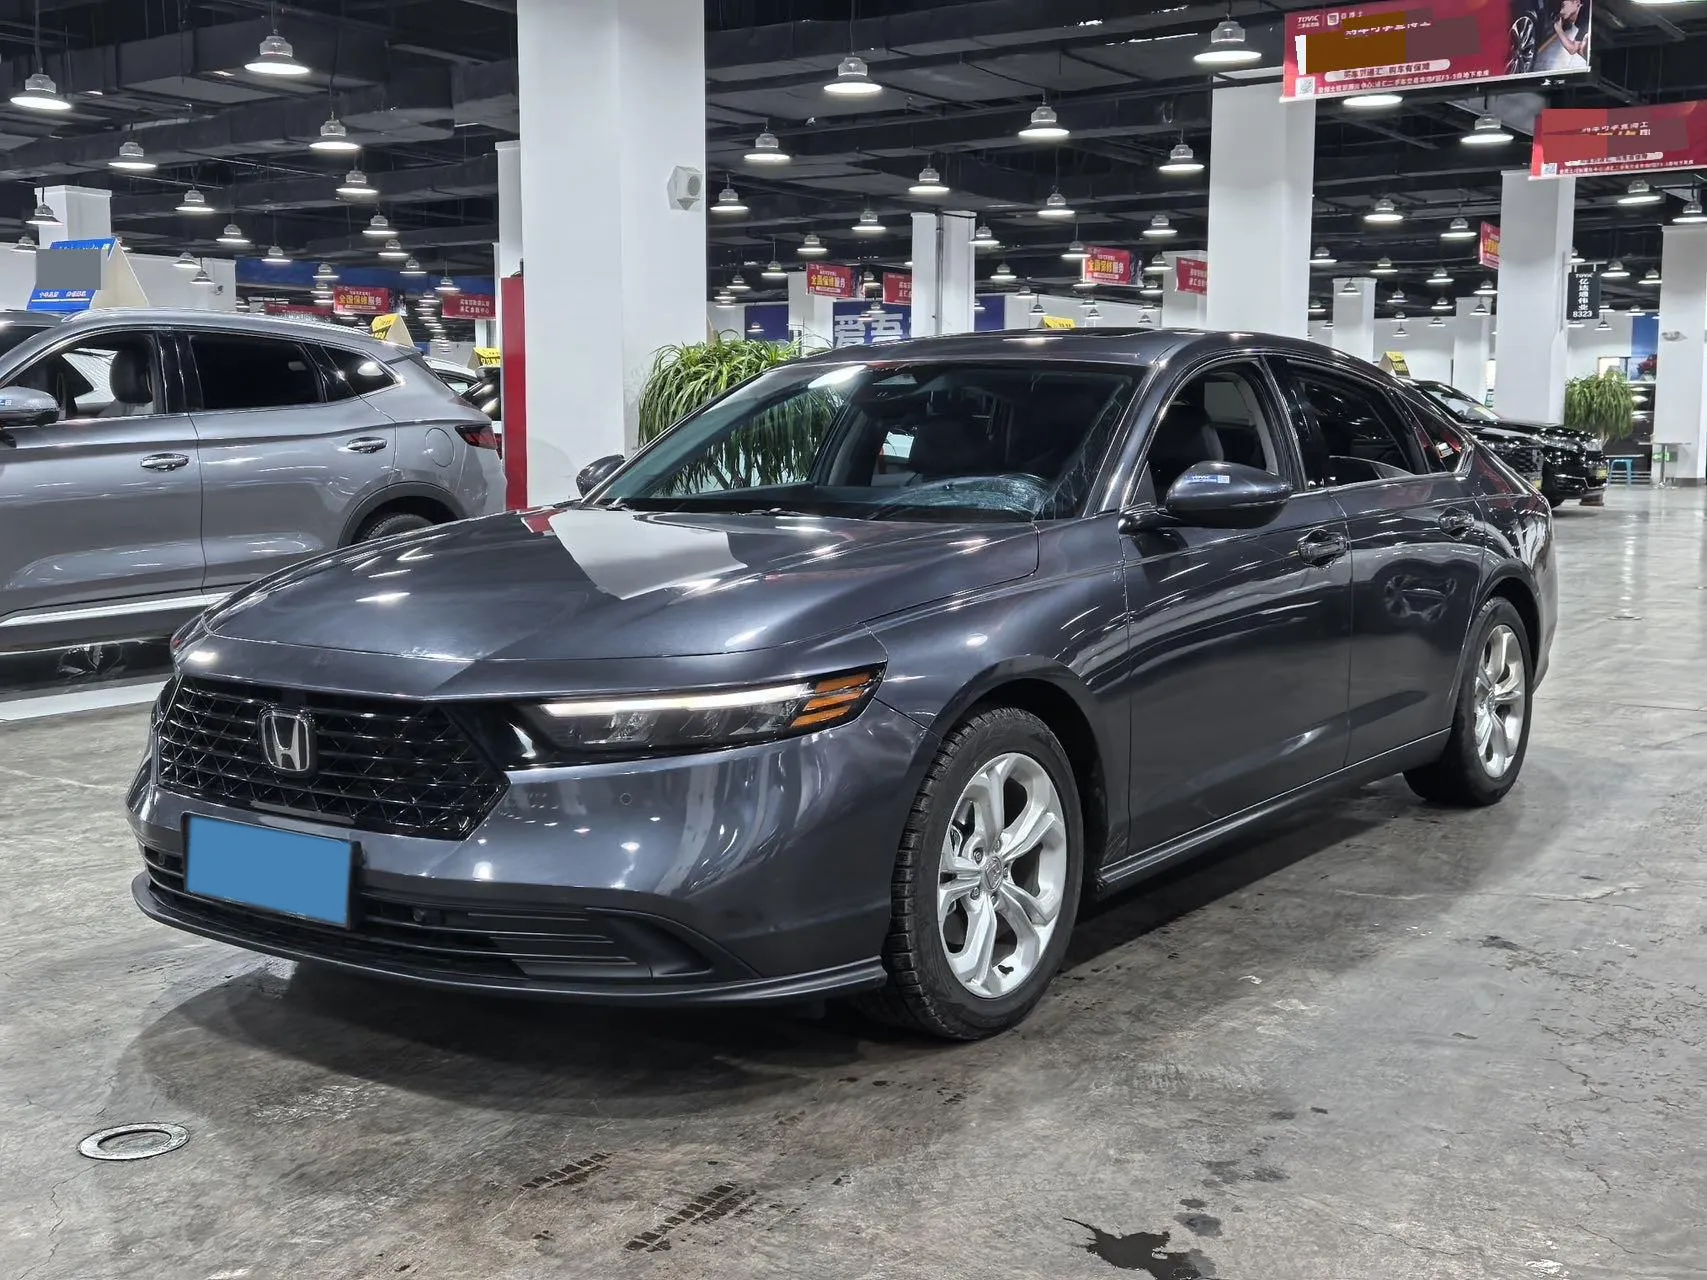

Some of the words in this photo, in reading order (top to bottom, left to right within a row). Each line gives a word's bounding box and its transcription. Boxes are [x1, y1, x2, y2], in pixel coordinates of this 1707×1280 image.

[339, 294, 382, 306] 全国保修服务
[1572, 310, 1593, 318] 8323
